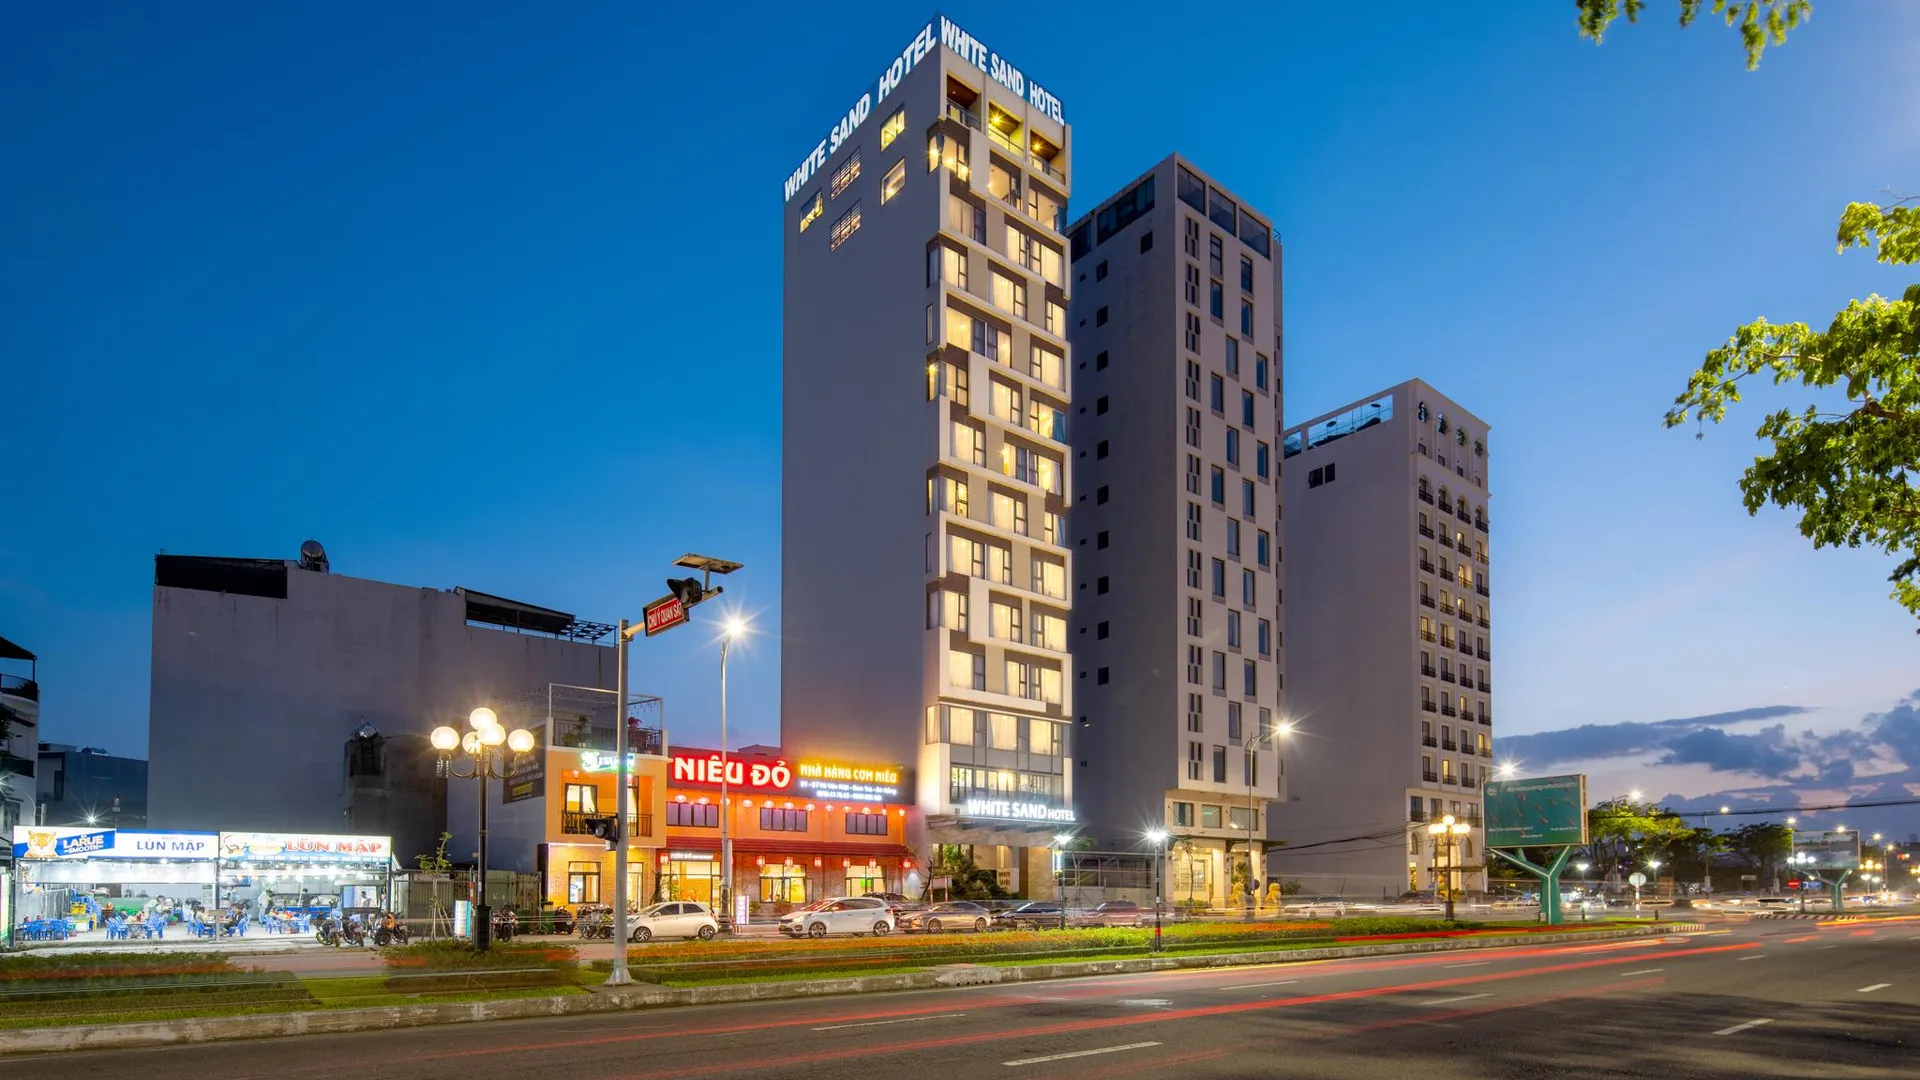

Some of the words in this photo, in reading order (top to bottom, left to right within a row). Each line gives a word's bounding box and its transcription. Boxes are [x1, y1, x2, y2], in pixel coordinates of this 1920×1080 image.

[941, 15, 987, 73] WHITE
[991, 52, 1024, 97] SAND
[1030, 80, 1065, 127] HOTEL
[785, 139, 827, 202] WHITE
[830, 93, 870, 154] SAND
[878, 23, 936, 104] HOTEL
[674, 755, 743, 785] NIÊU
[750, 760, 791, 788] ĐỎ
[800, 764, 822, 776] NHÀ
[824, 765, 852, 779] HÀNG
[968, 799, 1010, 816] WHITE
[1012, 802, 1047, 819] SAND
[1047, 809, 1076, 821] HOTEL
[64, 835, 104, 849] LARUE
